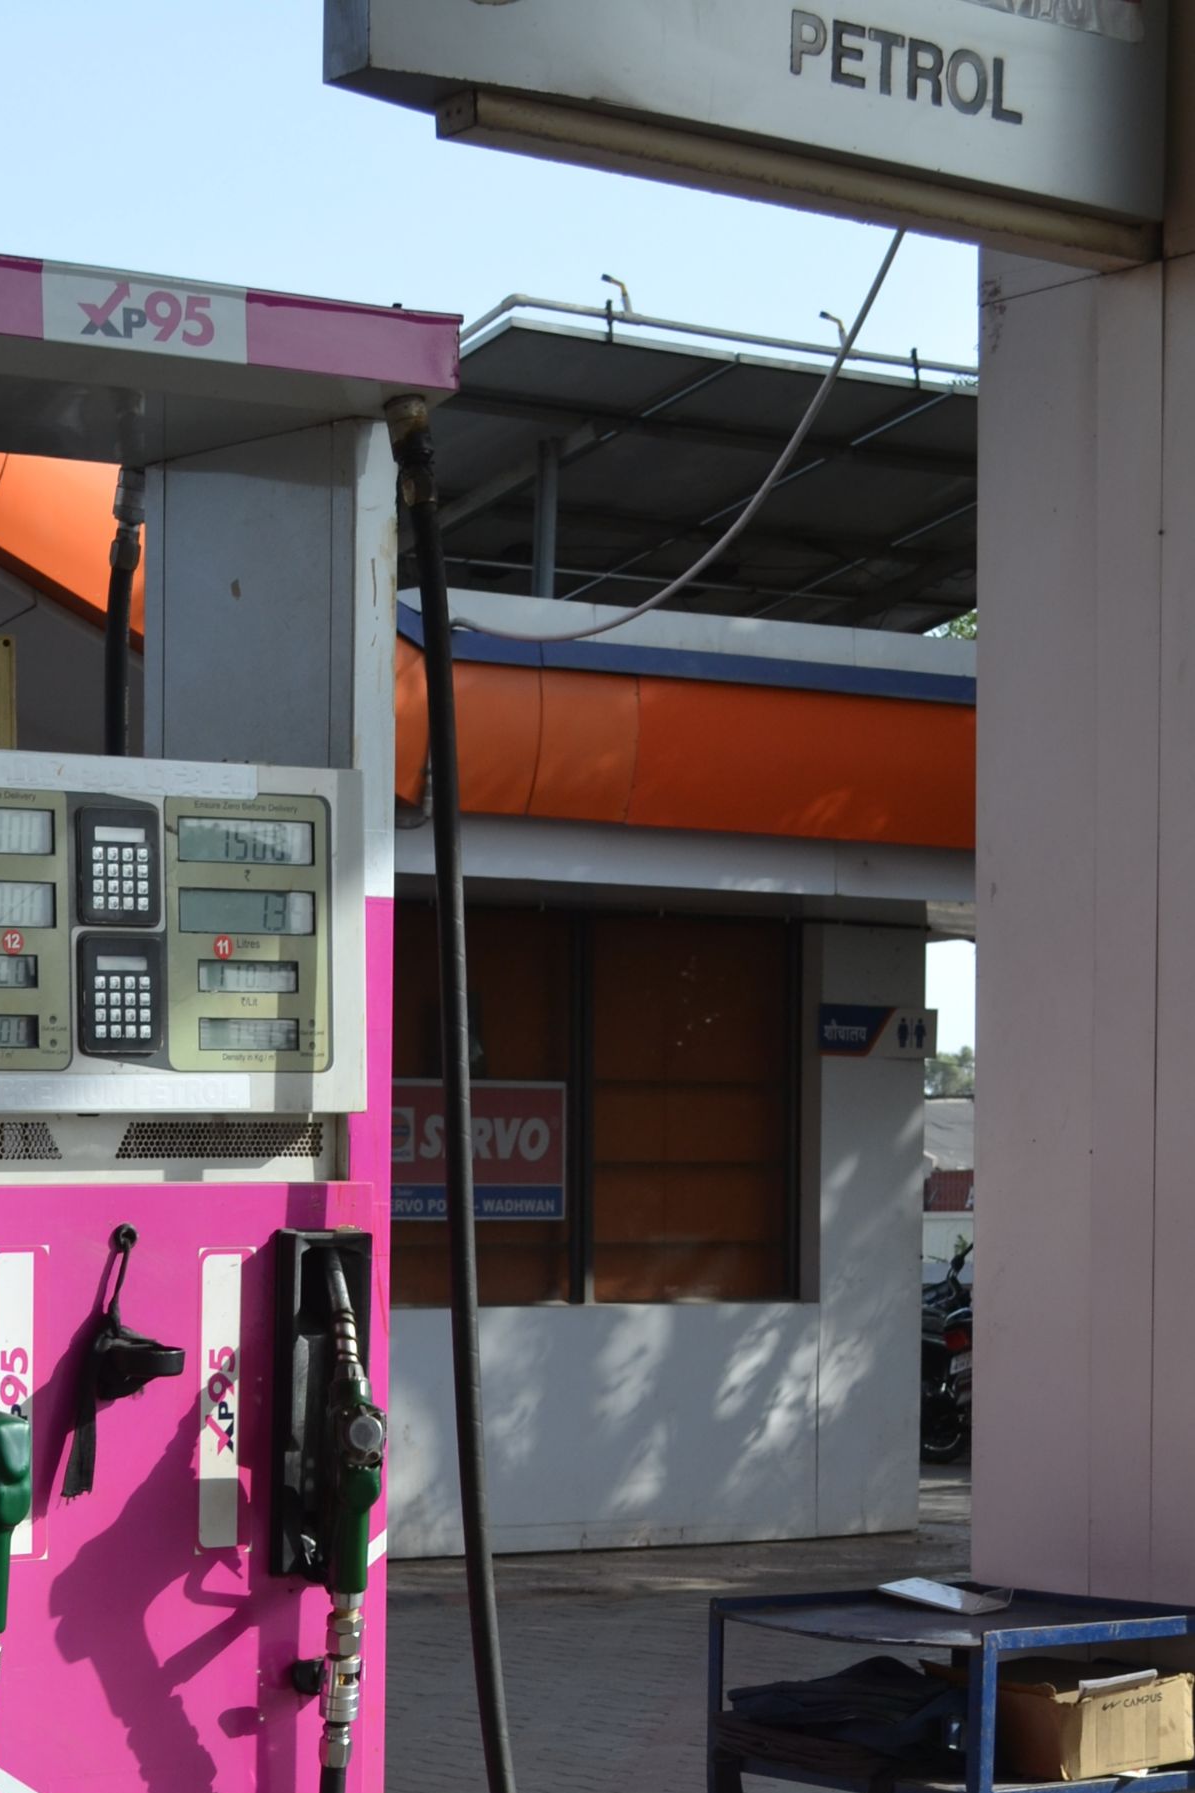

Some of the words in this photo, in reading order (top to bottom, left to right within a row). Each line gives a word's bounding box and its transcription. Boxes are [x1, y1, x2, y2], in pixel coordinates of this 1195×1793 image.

[790, 9, 1023, 125] PETROL
[77, 280, 215, 347] XP95
[5, 791, 37, 802] Delivery
[194, 801, 221, 810] Ensure
[223, 802, 240, 810] Zero
[242, 803, 266, 812] Before
[268, 804, 298, 814] Delivery
[5, 933, 21, 949] 12
[216, 940, 229, 955] 11
[236, 938, 260, 949] Litres
[823, 1018, 868, 1042] शौचालय
[222, 1053, 246, 1062] Density
[254, 1054, 264, 1063] Kg
[418, 1114, 550, 1161] SRVO
[482, 1199, 555, 1213] WADHWAN
[205, 1346, 236, 1456] XP95
[1122, 1692, 1164, 1708] CAMPUS
